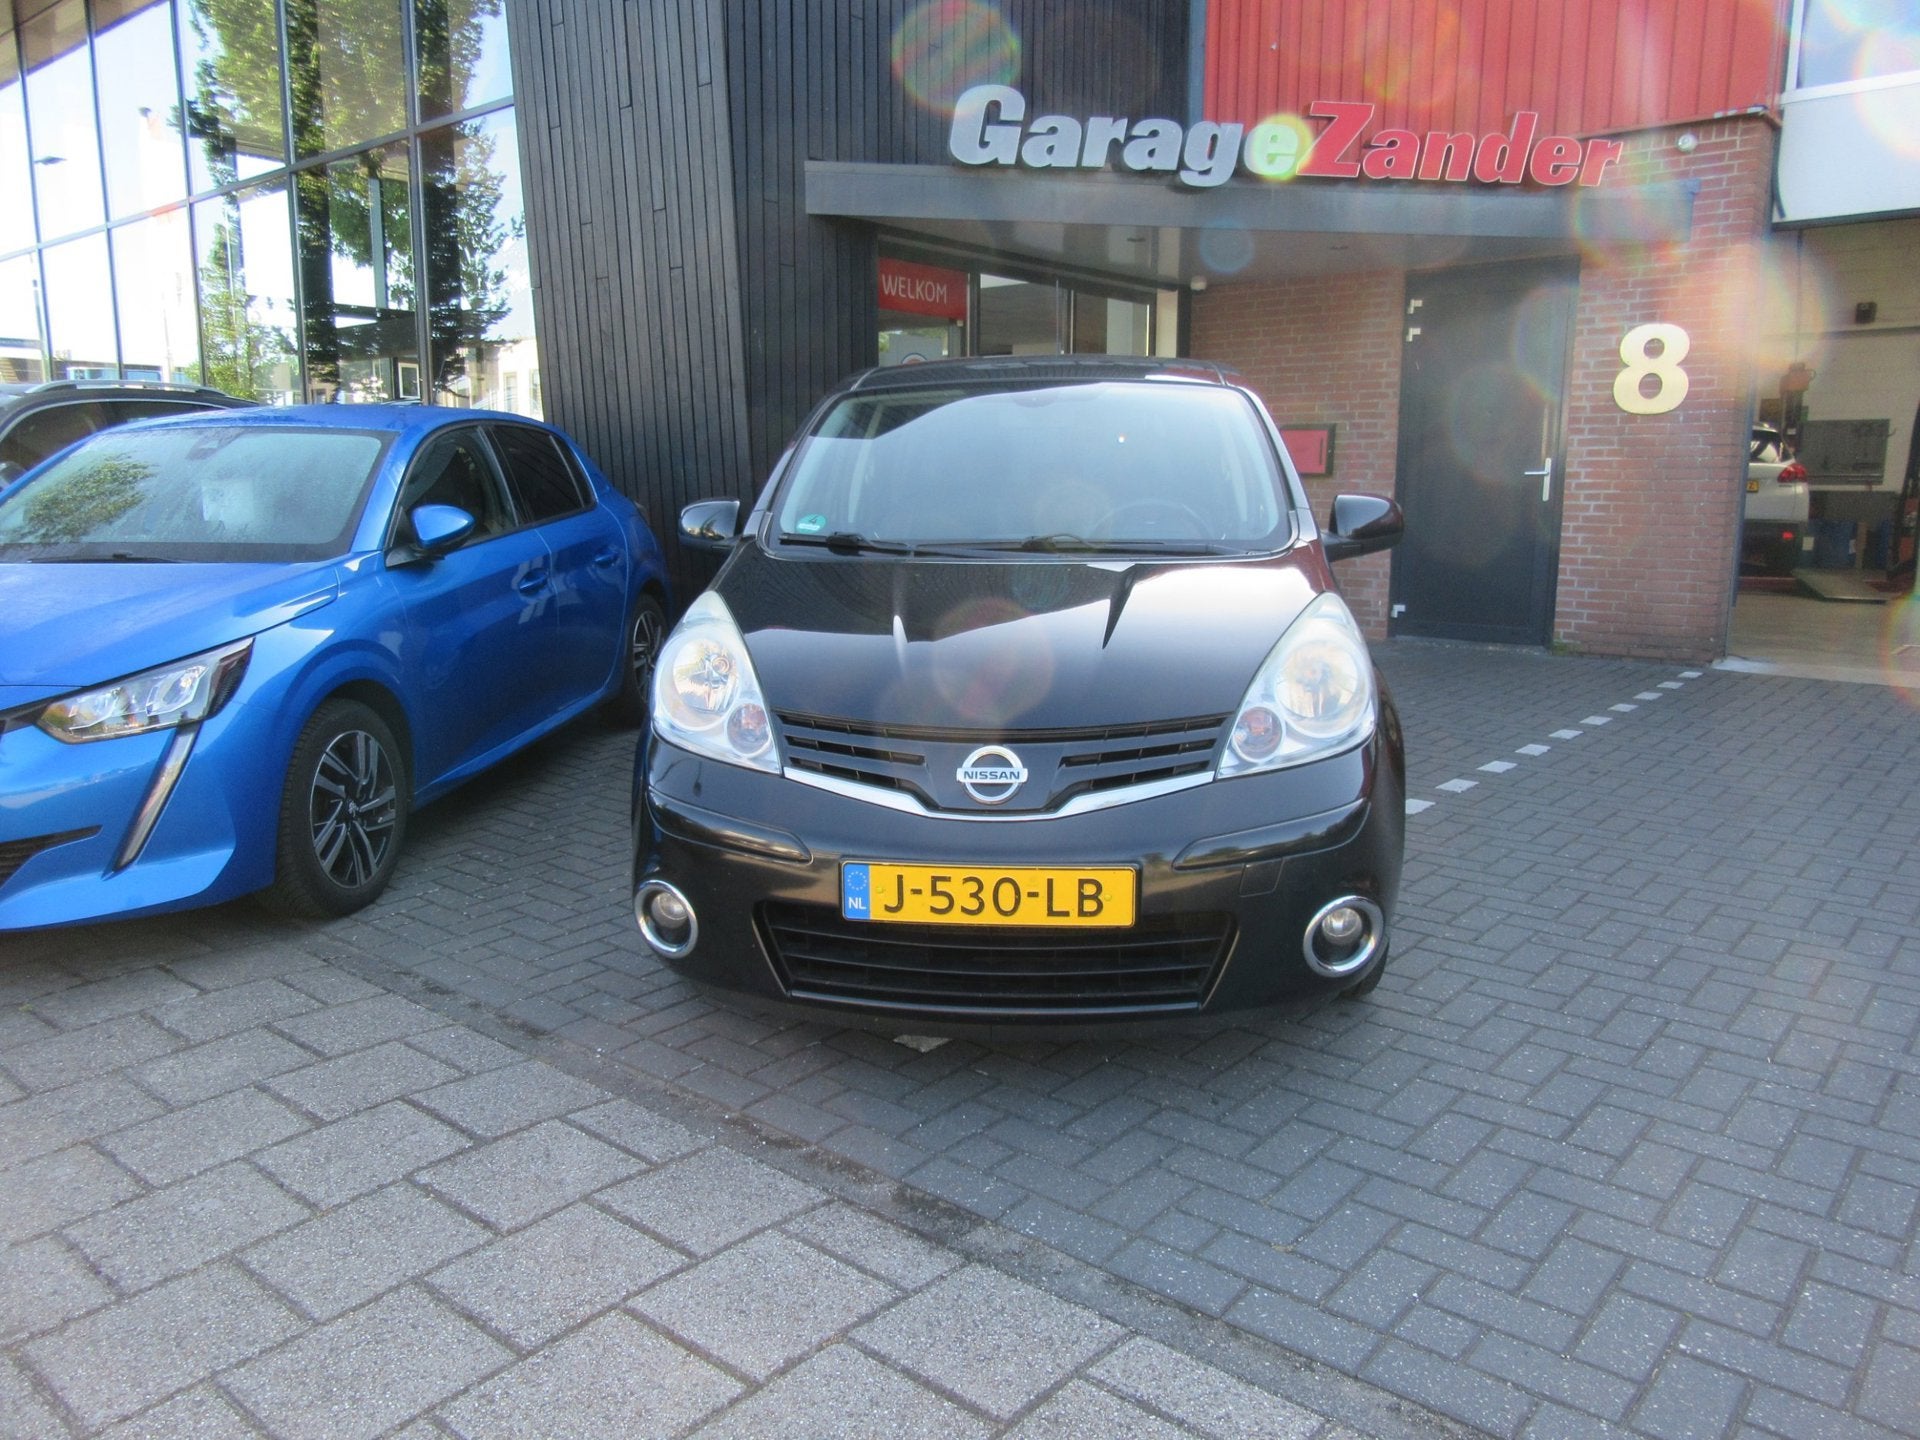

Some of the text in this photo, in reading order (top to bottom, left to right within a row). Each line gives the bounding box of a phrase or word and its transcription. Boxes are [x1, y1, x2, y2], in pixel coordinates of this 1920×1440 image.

[882, 274, 947, 304] WELKOM
[1613, 323, 1690, 415] 8
[963, 770, 1020, 780] NISSAN
[848, 896, 867, 909] NL
[884, 874, 1104, 918] J-530-LB
